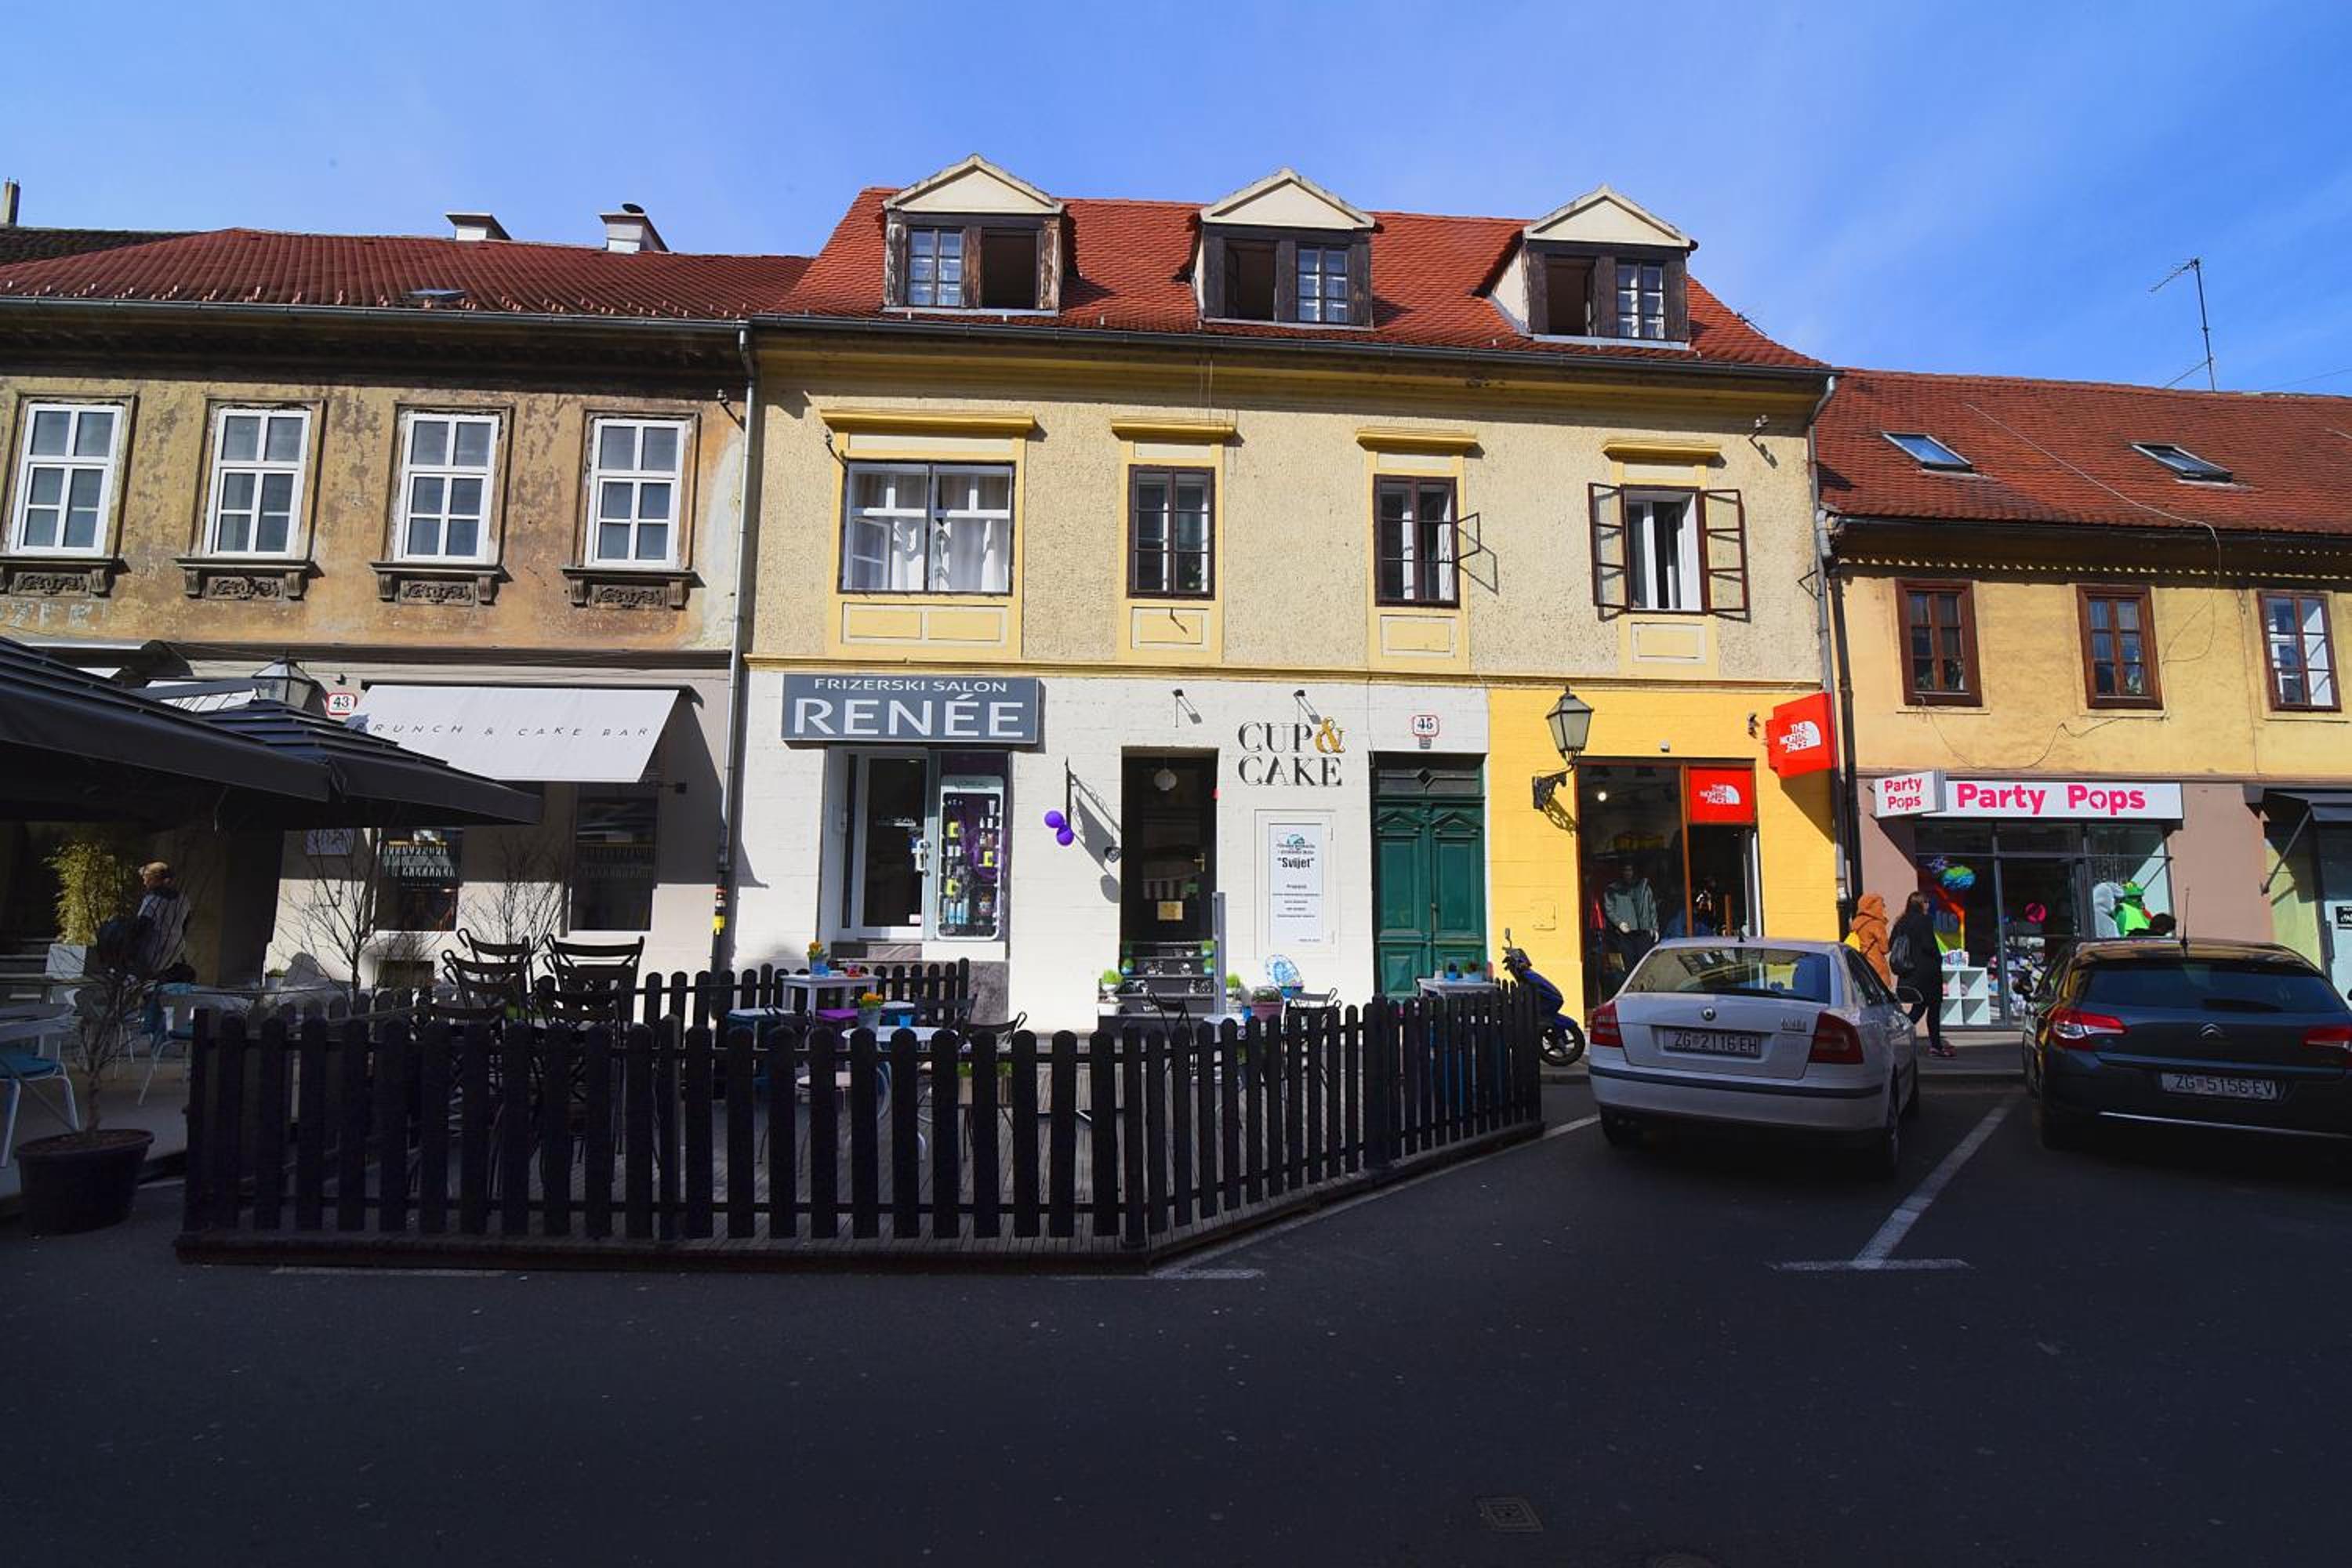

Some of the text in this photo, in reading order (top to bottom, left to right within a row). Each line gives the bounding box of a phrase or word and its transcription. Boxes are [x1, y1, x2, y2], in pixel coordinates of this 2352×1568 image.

[814, 678, 1008, 693] FRIZERSKI SALON
[332, 695, 351, 708] 43
[793, 693, 1024, 737] RENÉE
[517, 726, 582, 737] CAKE
[602, 726, 650, 736] BAR
[1417, 717, 1434, 730] 45
[1237, 755, 1344, 787] CAKE
[1884, 777, 1922, 793] Party
[1887, 795, 1922, 811] Pops
[1957, 783, 2147, 816] Party Pops
[1674, 1029, 1691, 1047] ZG
